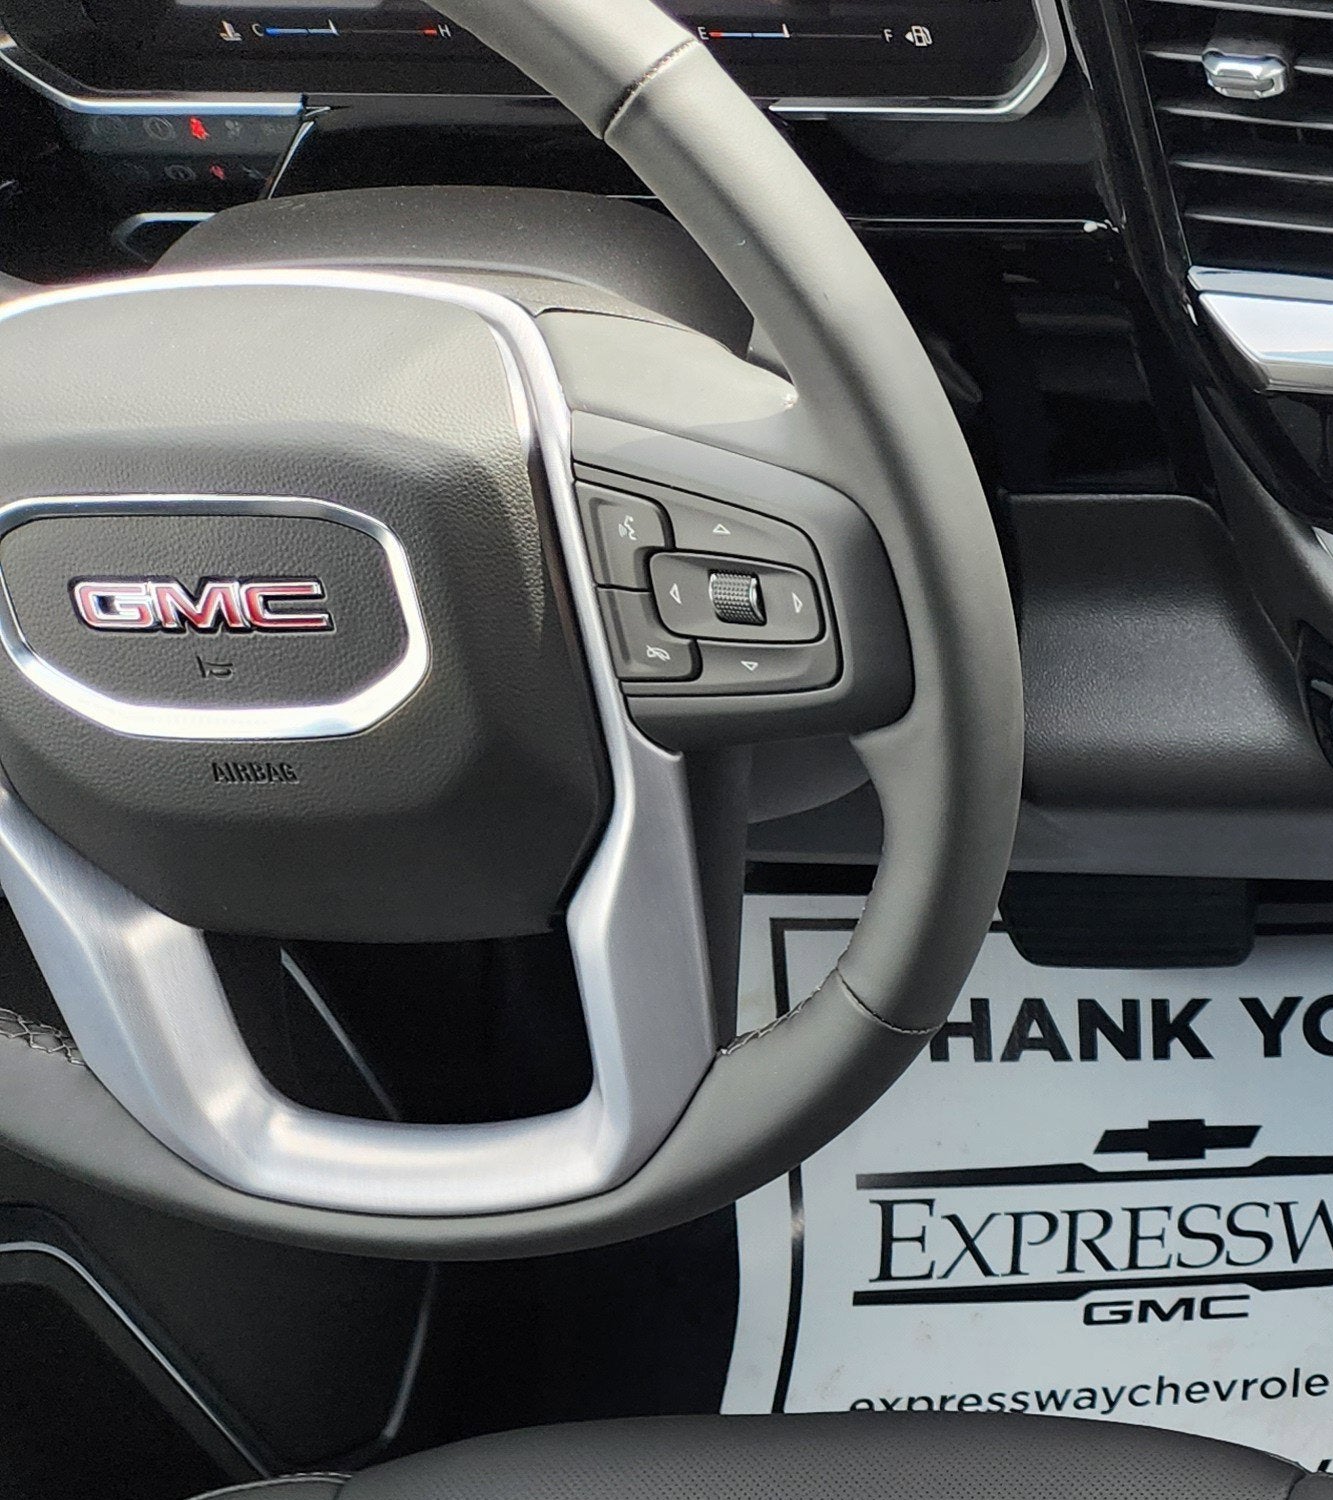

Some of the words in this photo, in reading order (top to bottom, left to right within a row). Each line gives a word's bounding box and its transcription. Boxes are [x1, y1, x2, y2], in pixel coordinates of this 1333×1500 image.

[437, 24, 451, 38] H
[883, 29, 893, 43] F
[74, 580, 331, 630] GMC
[210, 760, 298, 784] AIRBAG
[929, 996, 1214, 1063] HANK
[1083, 1294, 1250, 1326] GMC
